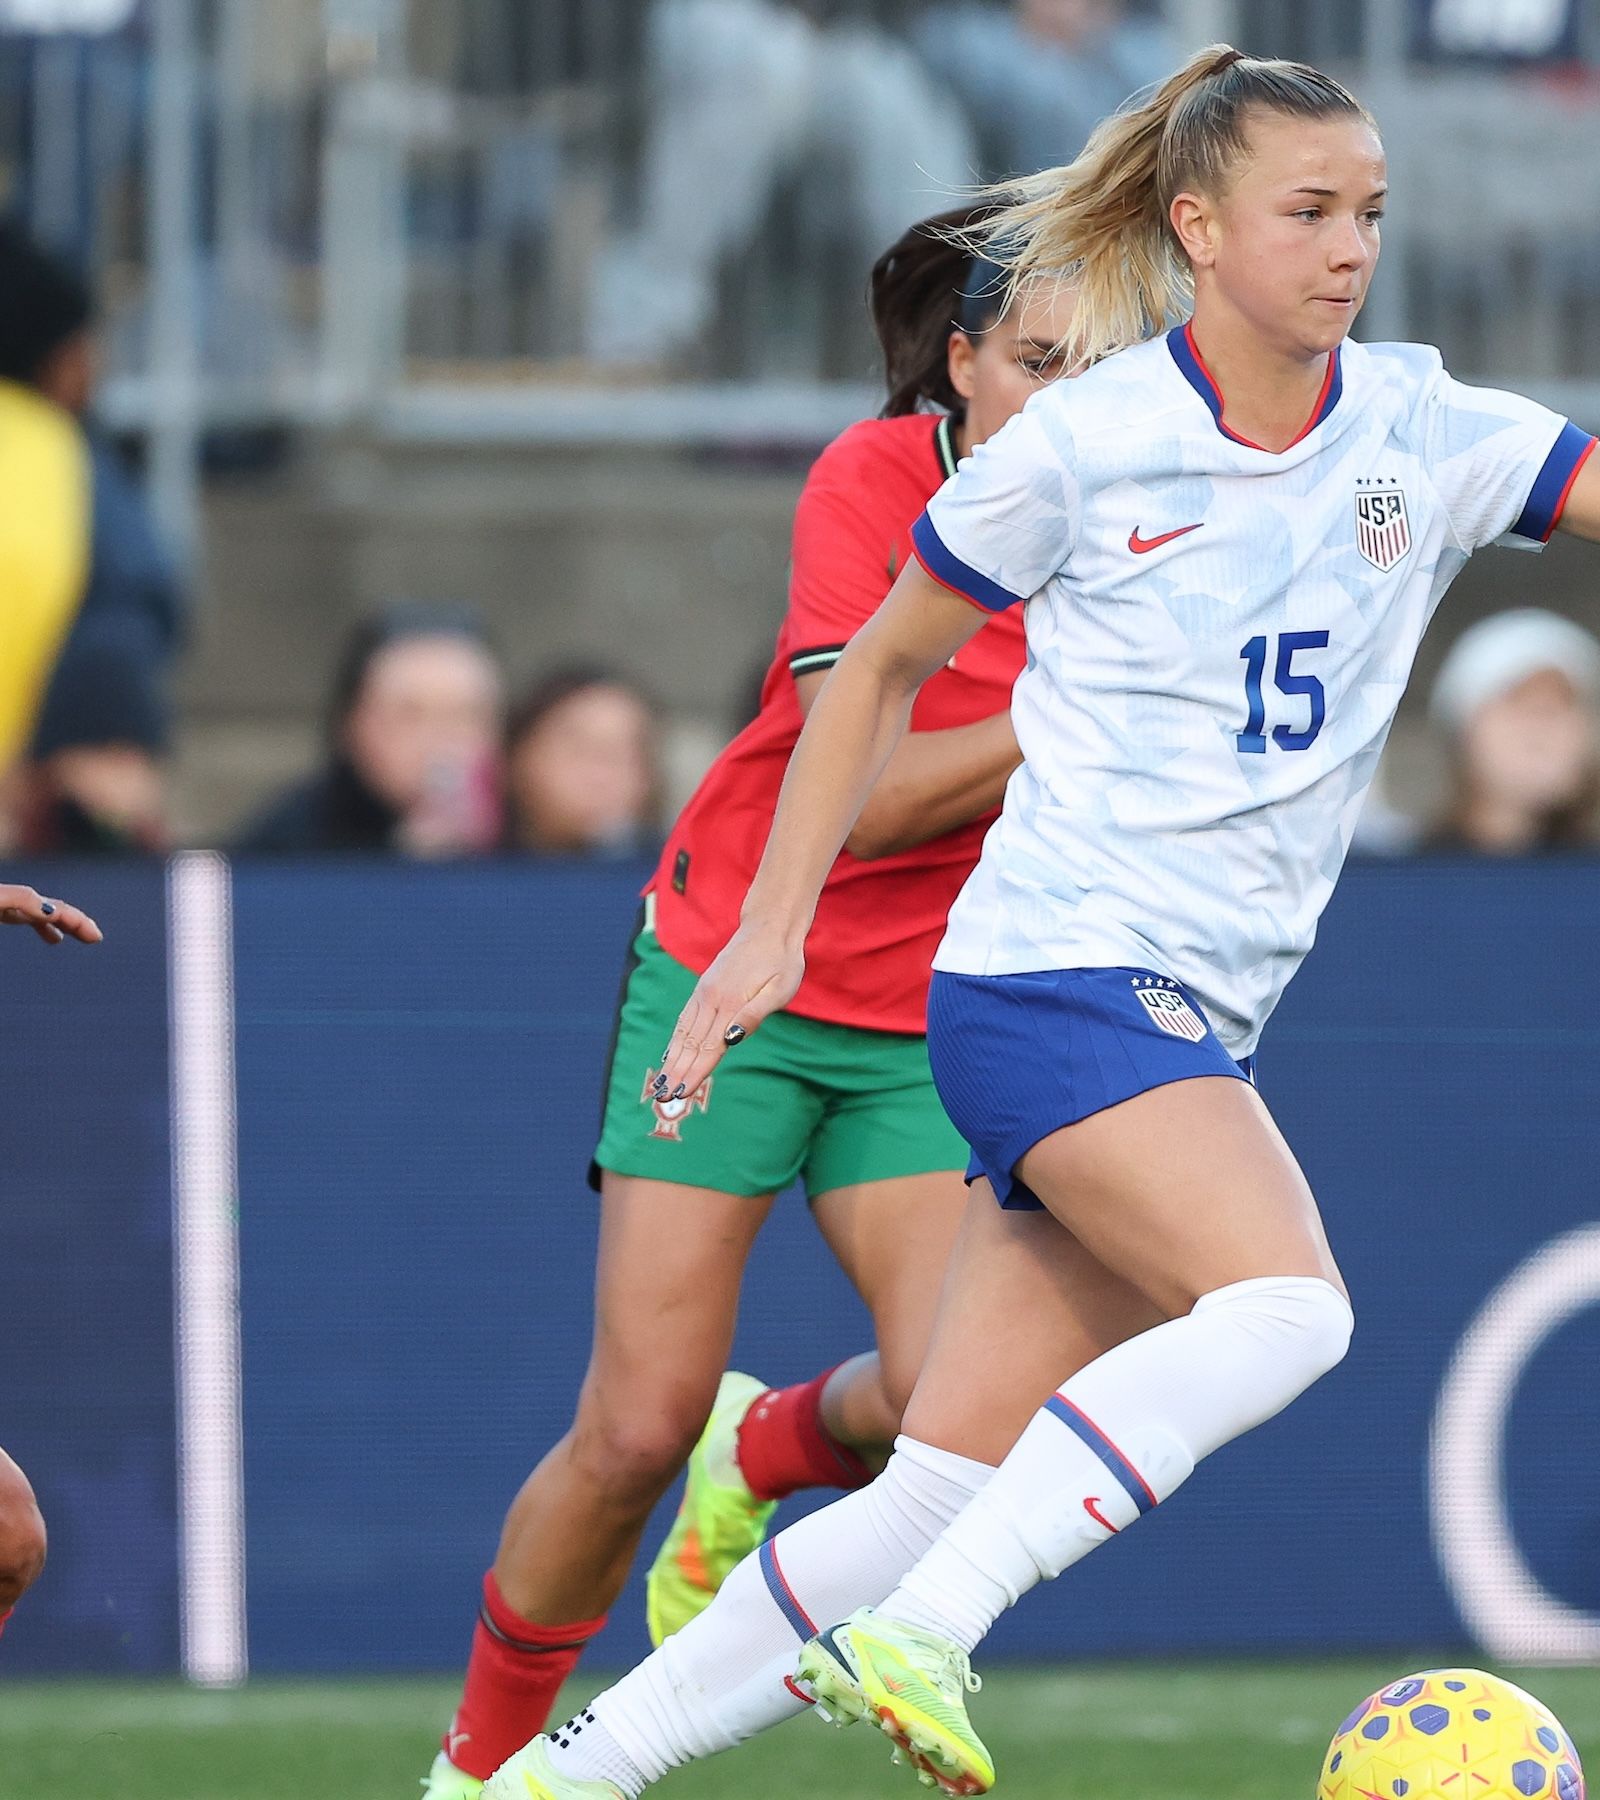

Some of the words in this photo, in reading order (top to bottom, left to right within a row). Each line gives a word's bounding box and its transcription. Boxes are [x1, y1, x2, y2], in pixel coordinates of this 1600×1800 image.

[1358, 495, 1402, 526] USA
[1236, 629, 1330, 754] 15
[1141, 991, 1187, 1012] USA
